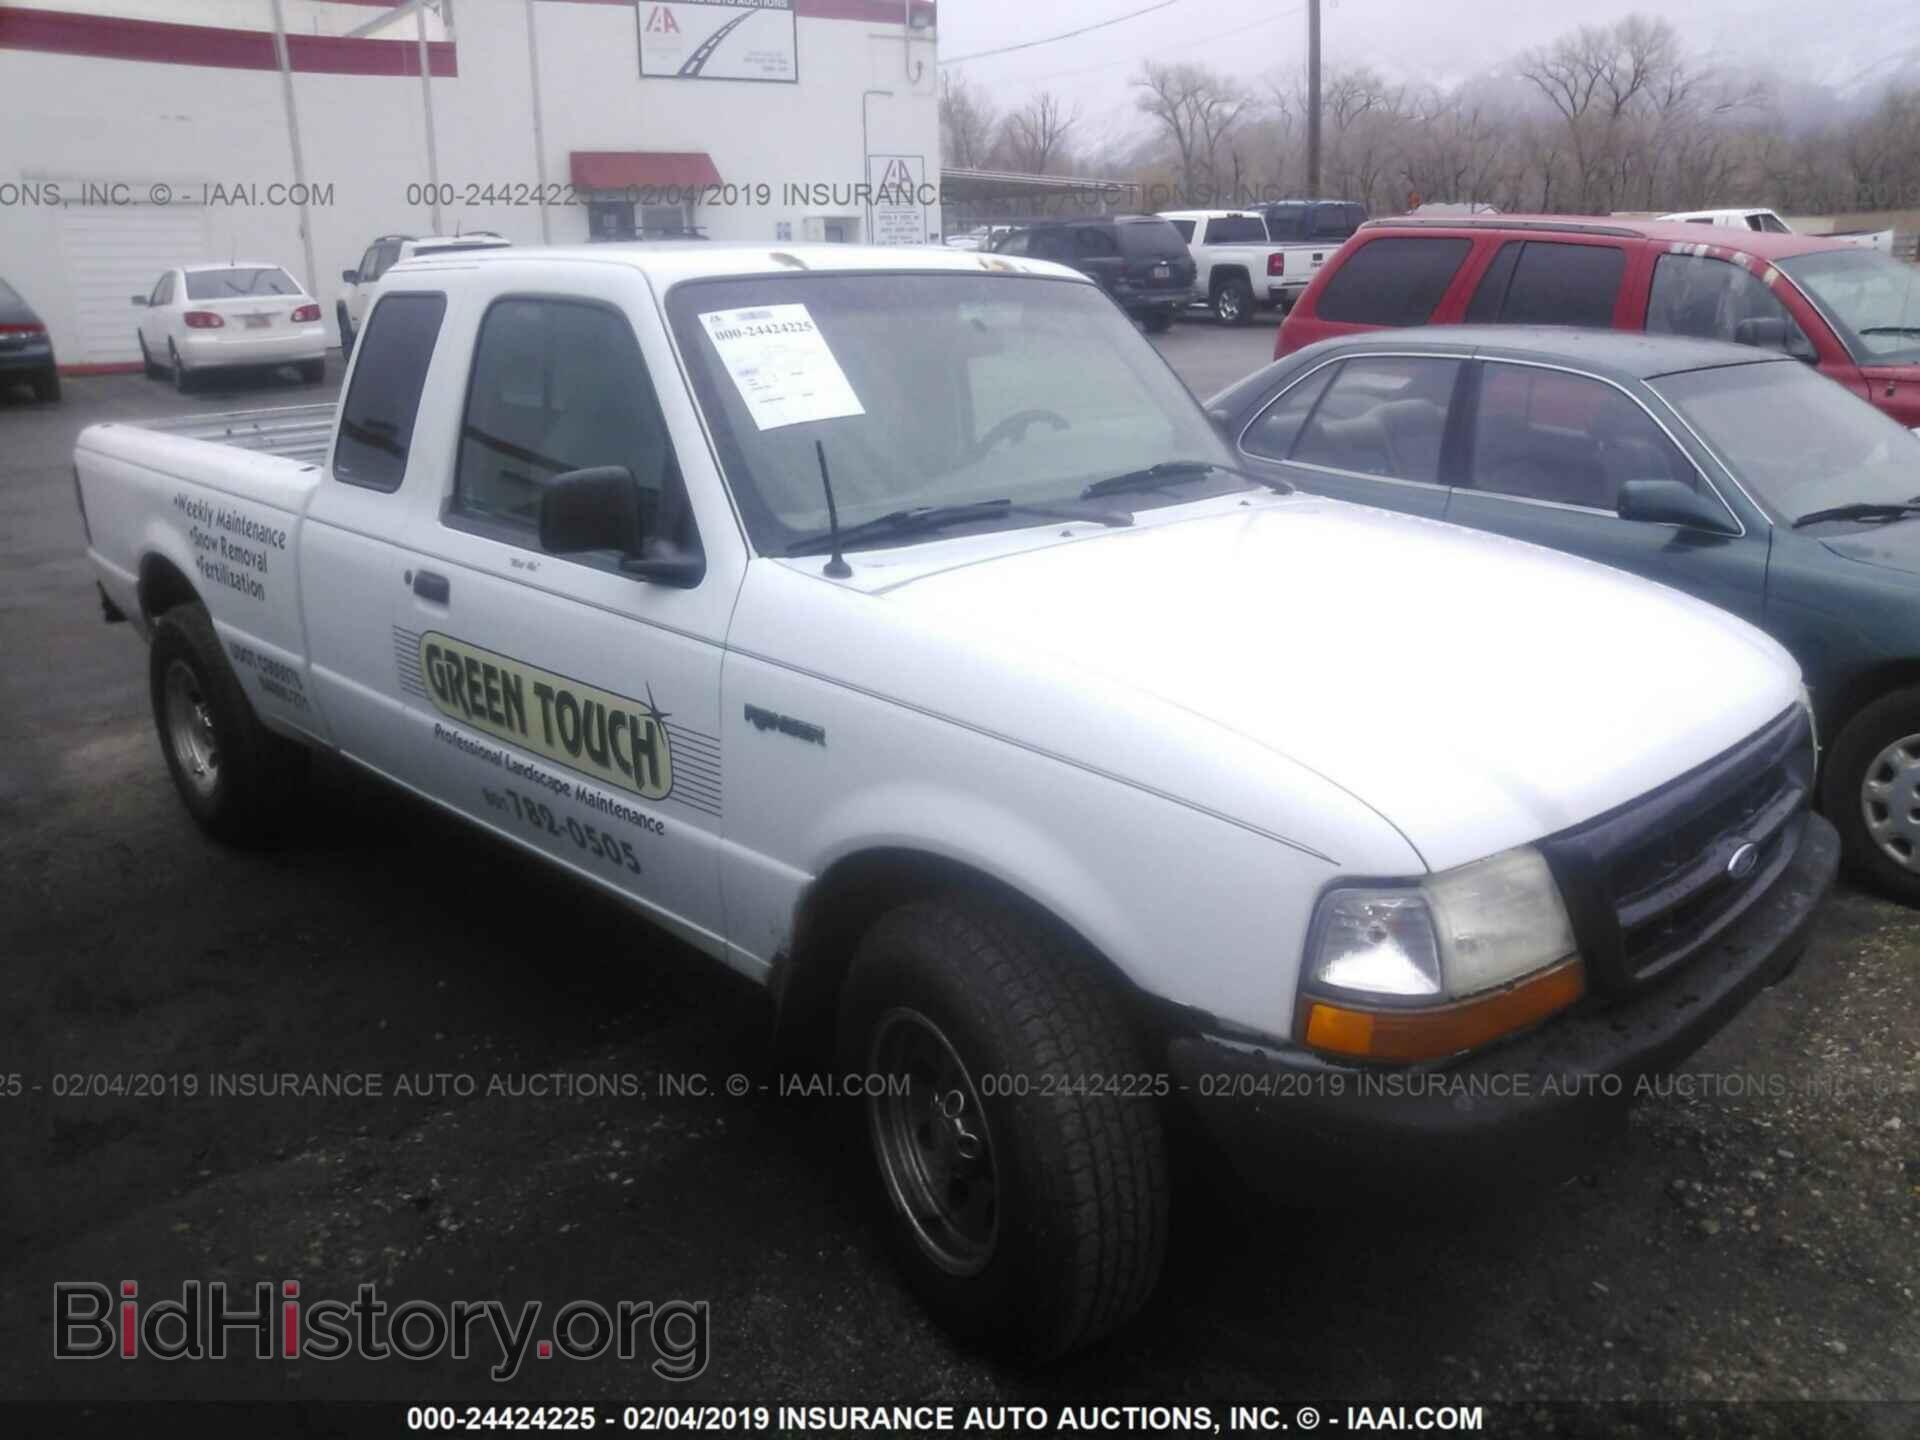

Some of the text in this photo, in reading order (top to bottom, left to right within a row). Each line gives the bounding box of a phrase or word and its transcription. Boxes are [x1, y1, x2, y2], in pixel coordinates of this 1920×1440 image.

[192, 525, 268, 574] Snow Removal
[216, 508, 287, 550] Maintenance
[199, 555, 266, 602] Fertilization
[425, 642, 529, 738] GREEN
[533, 681, 662, 790] TOUCH
[434, 722, 665, 836] Professional Landscape Maintenance
[505, 786, 642, 875] 782-0505
